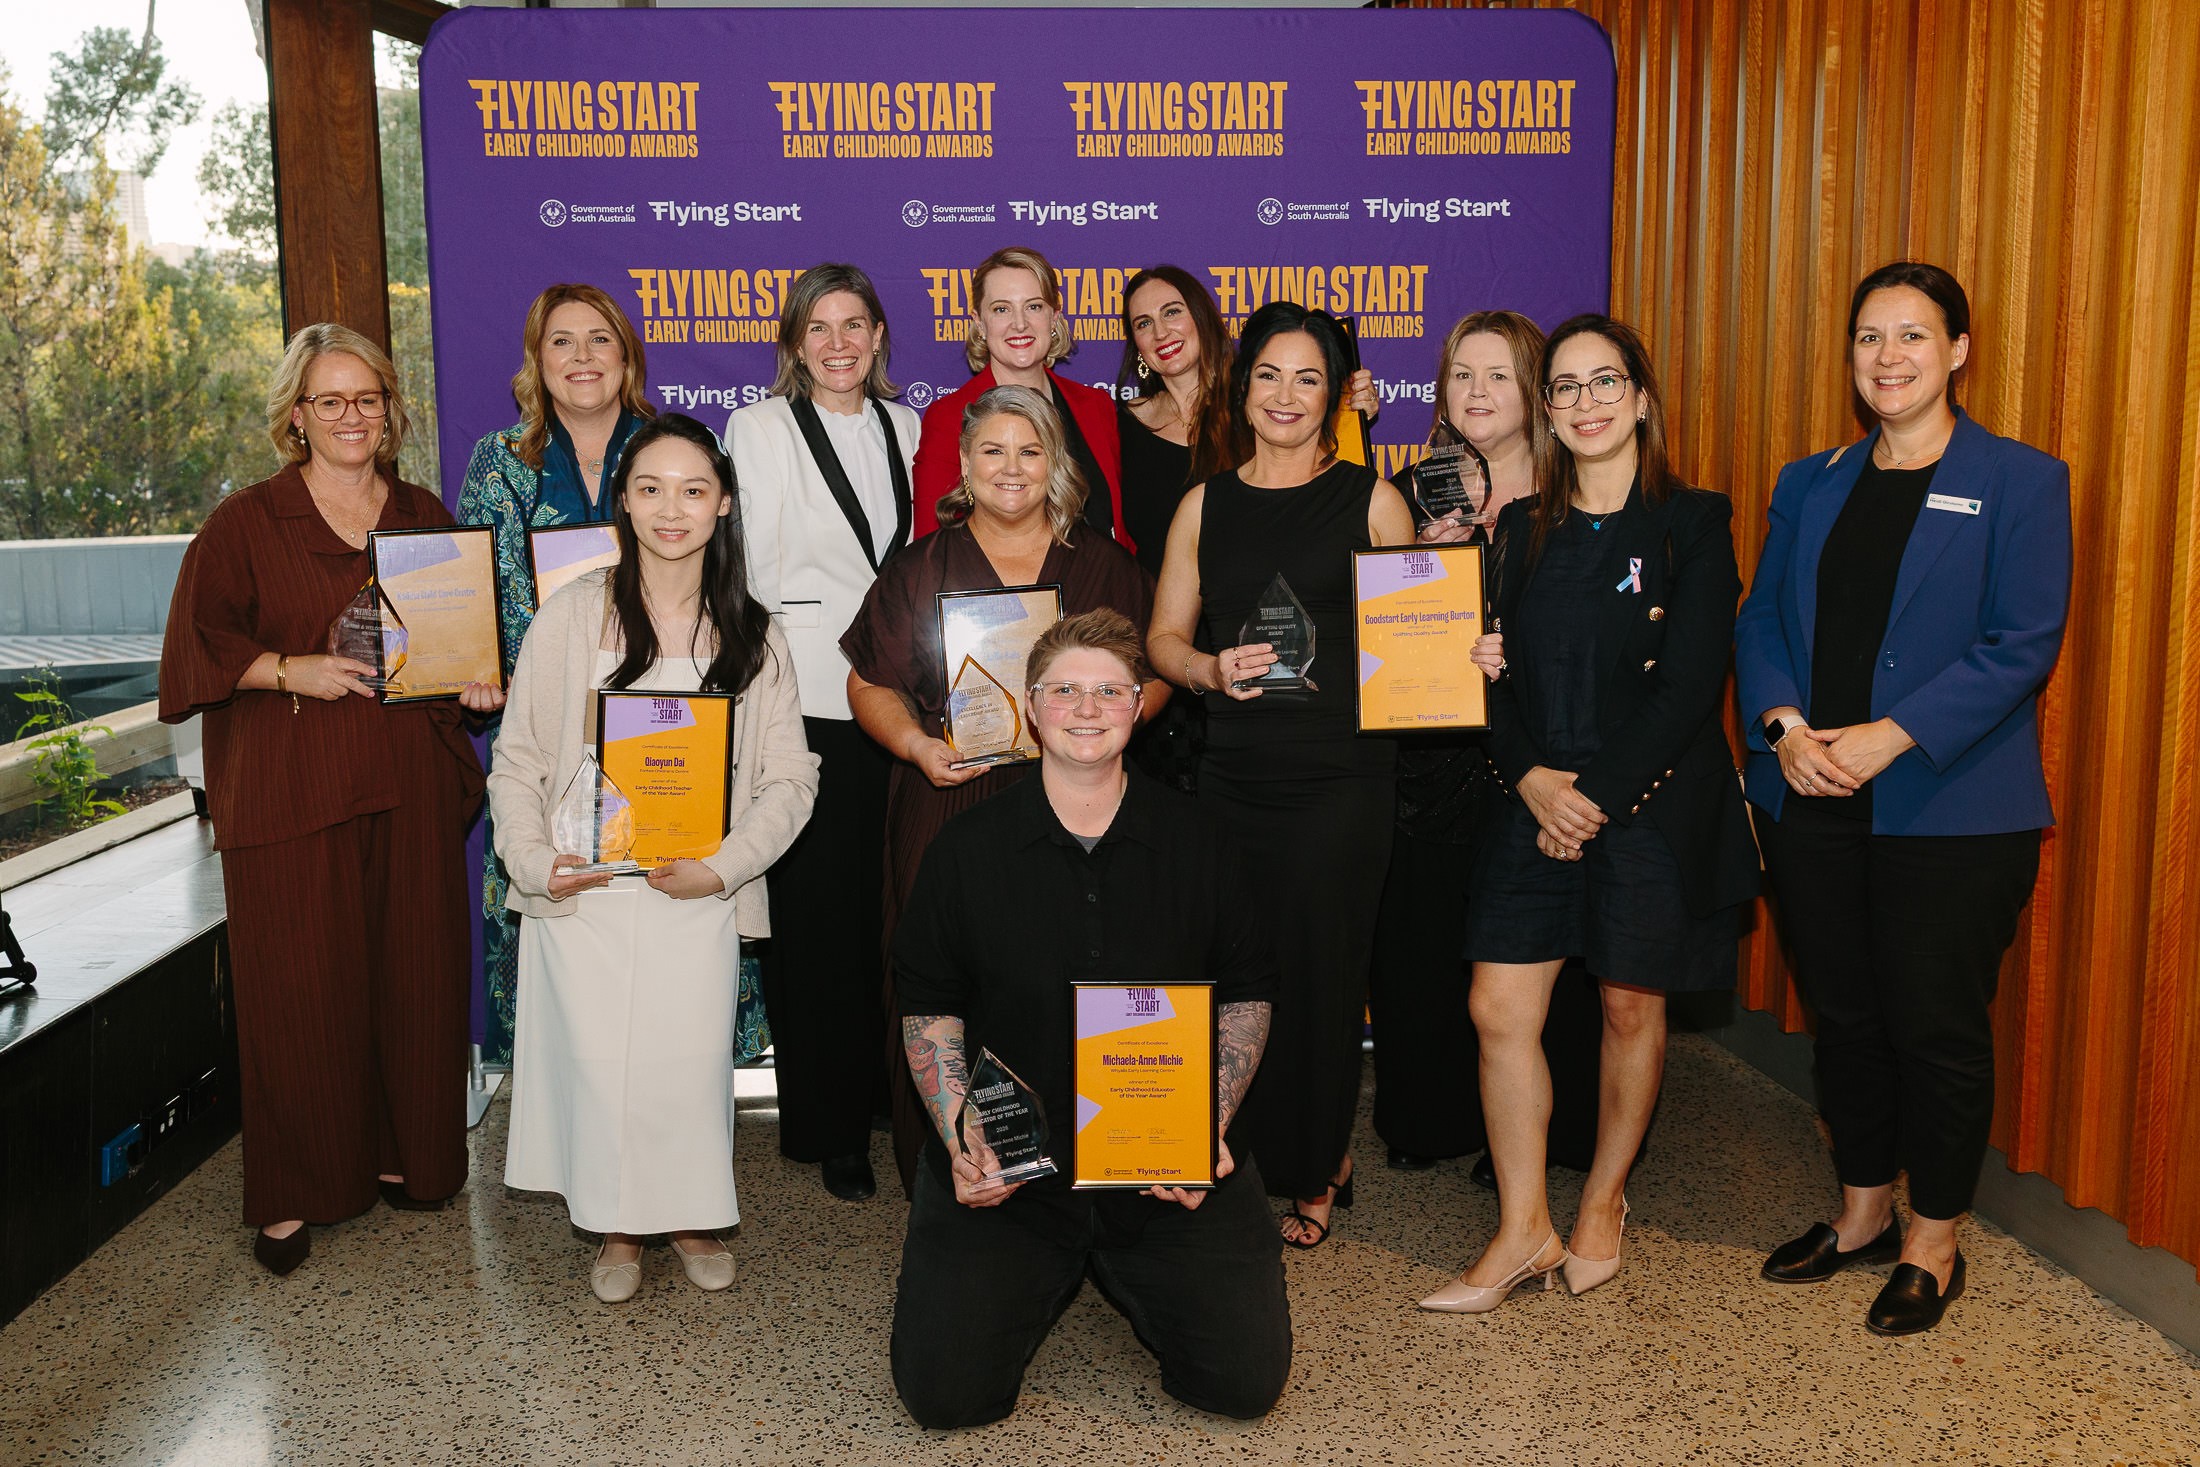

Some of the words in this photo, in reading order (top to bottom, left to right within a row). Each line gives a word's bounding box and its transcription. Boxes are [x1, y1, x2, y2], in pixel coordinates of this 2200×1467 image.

[469, 80, 594, 130] FLYING
[597, 81, 700, 131] START
[769, 82, 891, 131] FLYING
[894, 82, 996, 131] START
[1064, 82, 1183, 131] FLYING
[1187, 82, 1288, 130] START
[1355, 80, 1473, 129] FLYING
[1477, 80, 1576, 129] START
[484, 133, 531, 156] EARLY
[536, 134, 626, 157] CHILDHOOD
[630, 134, 699, 158] AWARDS
[783, 135, 829, 158] EARLY
[834, 135, 922, 158] CHILDHOOD
[926, 134, 993, 158] AWARDS
[1076, 135, 1123, 157] EARLY
[1127, 134, 1213, 157] CHILDHOOD
[1217, 133, 1284, 156] AWARDS
[1366, 133, 1412, 156] EARLY
[1416, 132, 1501, 155] CHILDHOOD
[1505, 132, 1571, 154] AWARDS
[570, 204, 624, 214] Government
[626, 204, 635, 214] of
[648, 200, 730, 227] Flying
[733, 202, 802, 222] Start
[932, 204, 985, 214] Government
[986, 204, 996, 214] of
[1008, 200, 1088, 226] Flying
[1092, 200, 1159, 221] Start
[1288, 202, 1339, 212] Government
[1340, 202, 1350, 212] of
[1362, 198, 1441, 223] Flying
[1445, 198, 1511, 218] Start
[571, 212, 597, 223] South
[598, 212, 636, 224] Australia
[932, 213, 958, 223] South
[959, 213, 996, 223] Australia
[1288, 211, 1312, 221] South
[1313, 211, 1350, 221] Australia
[628, 269, 751, 317] FLYING
[1208, 266, 1326, 313] FLYING
[1330, 265, 1428, 313] START
[644, 320, 690, 343] EARLY
[1358, 315, 1424, 338] AWARDS
[658, 385, 738, 410] Flying
[1402, 552, 1430, 564] FLYING
[1411, 563, 1434, 574] START
[1365, 614, 1399, 624] Goodstart
[1400, 612, 1417, 624] Early
[1420, 612, 1449, 623] Learning
[1450, 610, 1474, 620] Burton
[652, 698, 678, 709] FLYING
[660, 710, 682, 720] START
[645, 756, 672, 769] Qiaoyun
[674, 757, 685, 767] Dai
[1126, 988, 1156, 1000] FLYING
[1135, 1000, 1160, 1012] START
[1102, 1054, 1157, 1066] Michaela-Anne
[1158, 1054, 1183, 1066] Michie
[973, 1086, 995, 1099] FLYING
[994, 1082, 1014, 1095] START
[992, 1102, 1020, 1114] CHILDHOOD
[1136, 1168, 1160, 1176] Flying
